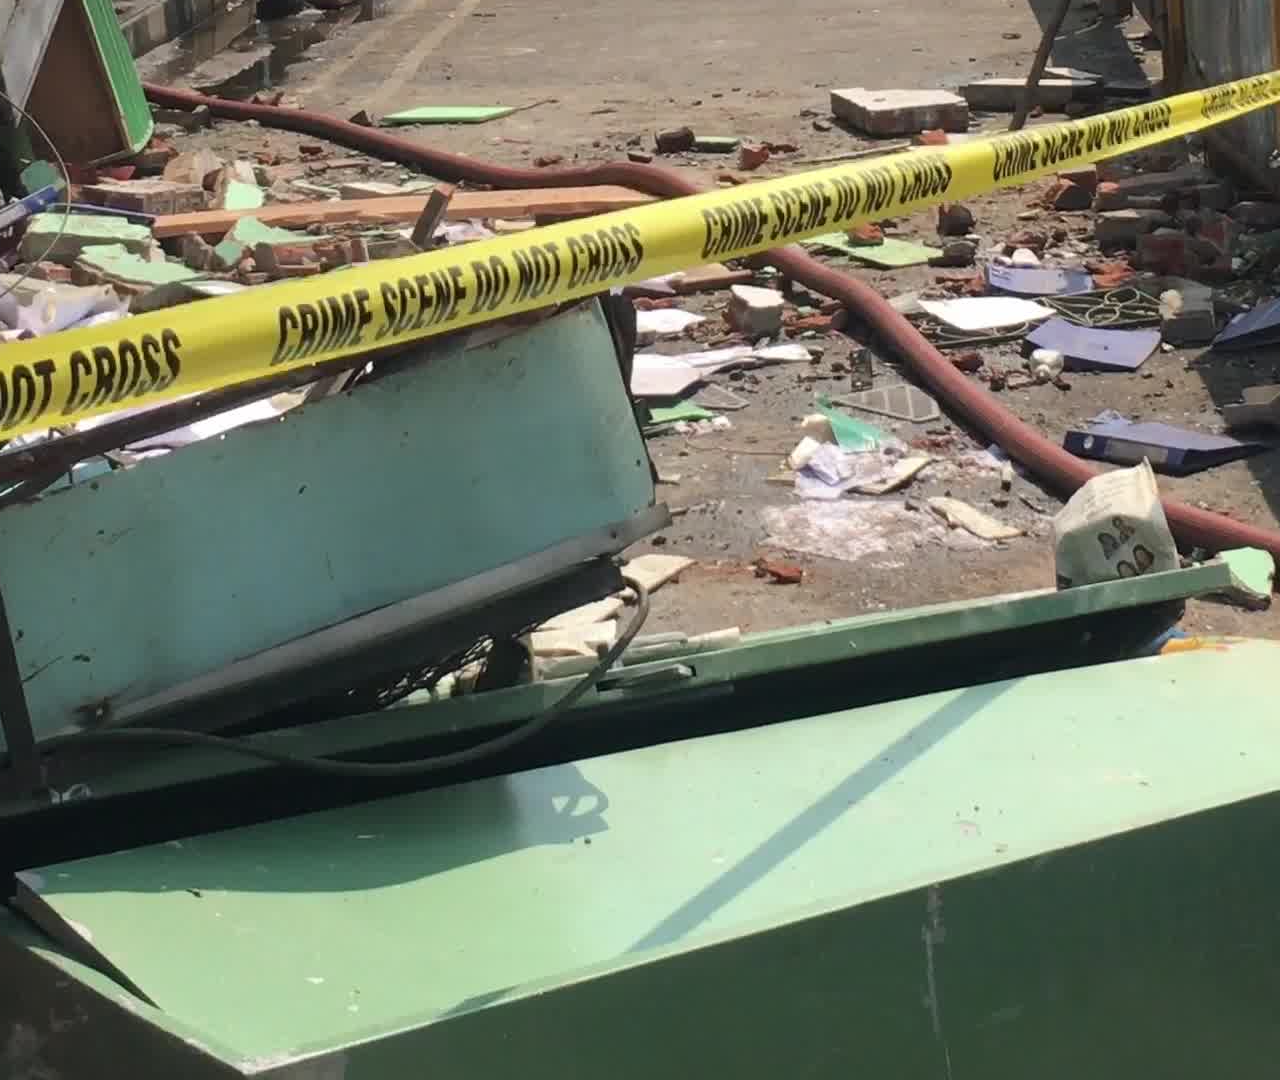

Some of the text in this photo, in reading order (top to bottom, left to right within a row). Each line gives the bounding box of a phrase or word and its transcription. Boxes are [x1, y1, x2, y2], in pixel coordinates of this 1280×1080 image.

[701, 152, 953, 259] CRIME SCENE DO NOT CROSS
[272, 222, 644, 367] CRIME SCENE DO NOT CROSS
[64, 327, 184, 417] CROSS
